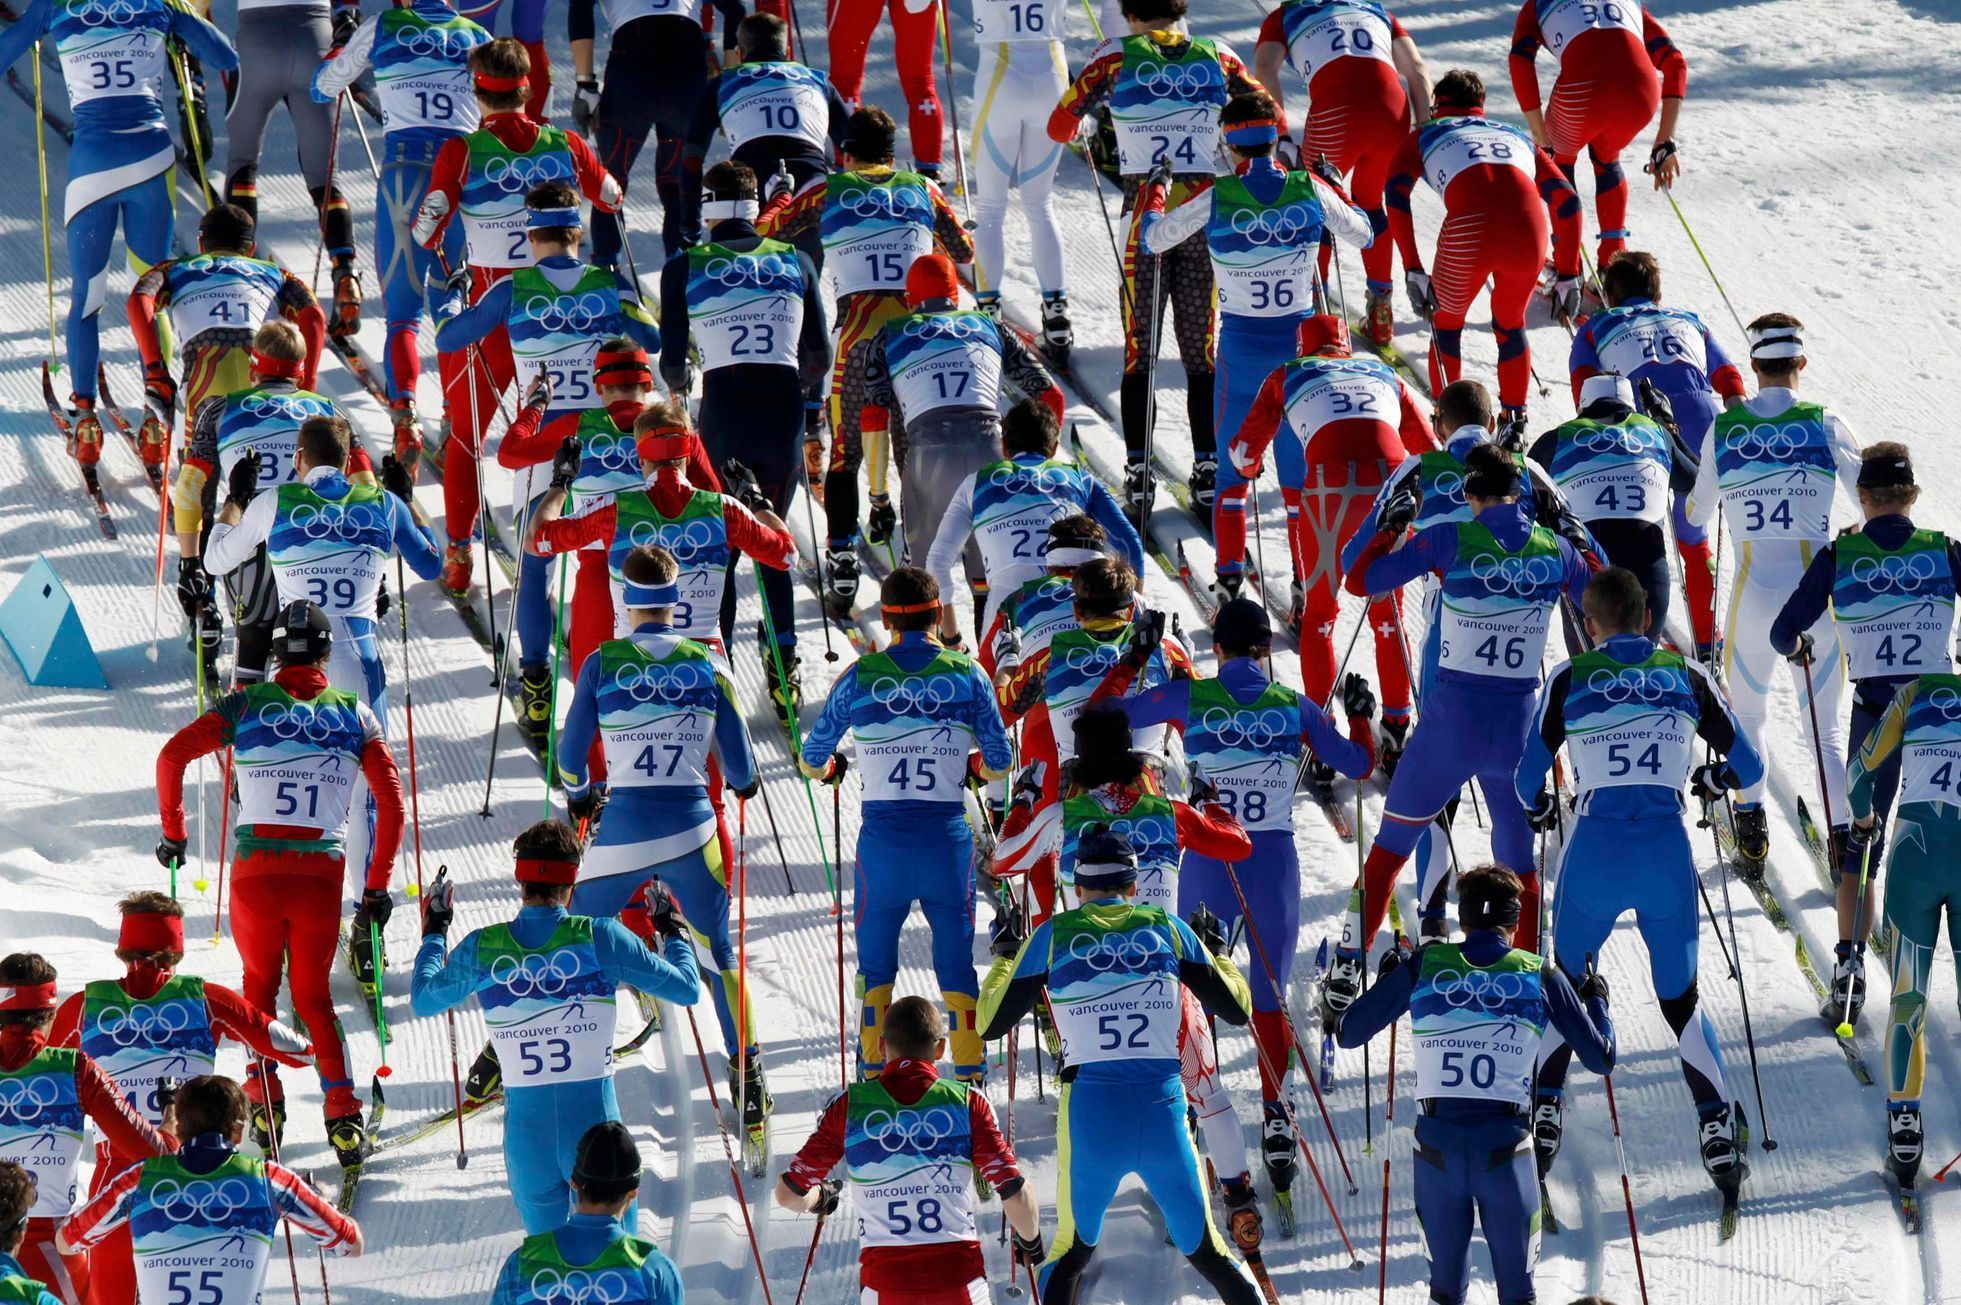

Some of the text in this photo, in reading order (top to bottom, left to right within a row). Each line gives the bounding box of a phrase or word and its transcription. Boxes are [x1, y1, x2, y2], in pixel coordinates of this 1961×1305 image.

[1010, 3, 1044, 32] 16
[1580, 4, 1623, 24] 30
[1305, 20, 1364, 40] vancouver
[1327, 28, 1373, 51] 20
[69, 49, 155, 64] vancouver 2010
[91, 61, 135, 90] 35
[390, 82, 449, 92] vancouver
[415, 92, 453, 120] 19
[735, 97, 794, 113] vancouver
[760, 104, 799, 130] 10
[1128, 123, 1213, 136] vancouver 2010
[1151, 136, 1195, 164] 24
[1440, 136, 1499, 152] vancouver
[1465, 141, 1512, 160] 28
[479, 219, 528, 230] vancouv
[507, 231, 527, 260] 2
[838, 242, 924, 256] vancouver 2010
[865, 254, 903, 282] 15
[1227, 267, 1311, 279] vancouver 2010
[183, 292, 242, 306] vancouver
[1250, 279, 1294, 309] 36
[210, 301, 249, 322] 41
[702, 313, 795, 328] vancouver 2010
[728, 325, 774, 355] 23
[1612, 330, 1670, 347] vancouver
[1638, 335, 1683, 358] 26
[905, 360, 965, 381] vancouver
[547, 370, 589, 400] 25
[932, 372, 970, 398] 17
[1302, 385, 1367, 404] vancouver
[1330, 393, 1378, 413] 32
[260, 453, 297, 481] 37
[1570, 474, 1664, 491] vancouver 2010
[1595, 487, 1646, 511] 43
[1726, 487, 1817, 501] vancouver 2010
[1744, 500, 1793, 531] 34
[987, 518, 1047, 534] vancouver
[1011, 530, 1050, 557] 22
[285, 567, 376, 580] vancouver 2010
[308, 579, 356, 608] 39
[689, 590, 715, 599] 2010
[1033, 622, 1081, 640] vancouv
[1457, 618, 1544, 635] vancouver 2010
[1851, 621, 1943, 635] vancouver 2010
[1475, 636, 1525, 669] 46
[1875, 635, 1922, 666] 42
[610, 731, 704, 742] vancouver 2010
[1582, 731, 1685, 746] vancouver 2010
[634, 745, 683, 776] 47
[864, 745, 959, 756] vancouver 2010
[1608, 743, 1662, 776] 54
[1914, 748, 1961, 761] vancouv
[249, 769, 347, 786] vancouver 2010
[888, 758, 936, 791] 45
[1262, 779, 1287, 790] 2010
[1930, 762, 1961, 793] 4
[275, 782, 318, 817] 51
[1217, 791, 1266, 822] 38
[1146, 888, 1170, 897] 2010
[1342, 923, 1352, 943] 6
[1069, 1000, 1173, 1015] vancouver 2010
[494, 1023, 597, 1040] vancouver 2010
[1099, 1014, 1149, 1050] 52
[520, 1039, 572, 1075] 53
[1421, 1037, 1523, 1057] vancouver 2010
[1441, 1053, 1496, 1088] 50
[32, 1157, 65, 1167] 2010
[864, 1184, 961, 1198] vancouver 2010
[888, 1199, 942, 1235] 58
[144, 1256, 254, 1270] vancouver 2010
[168, 1272, 224, 1305] 55
